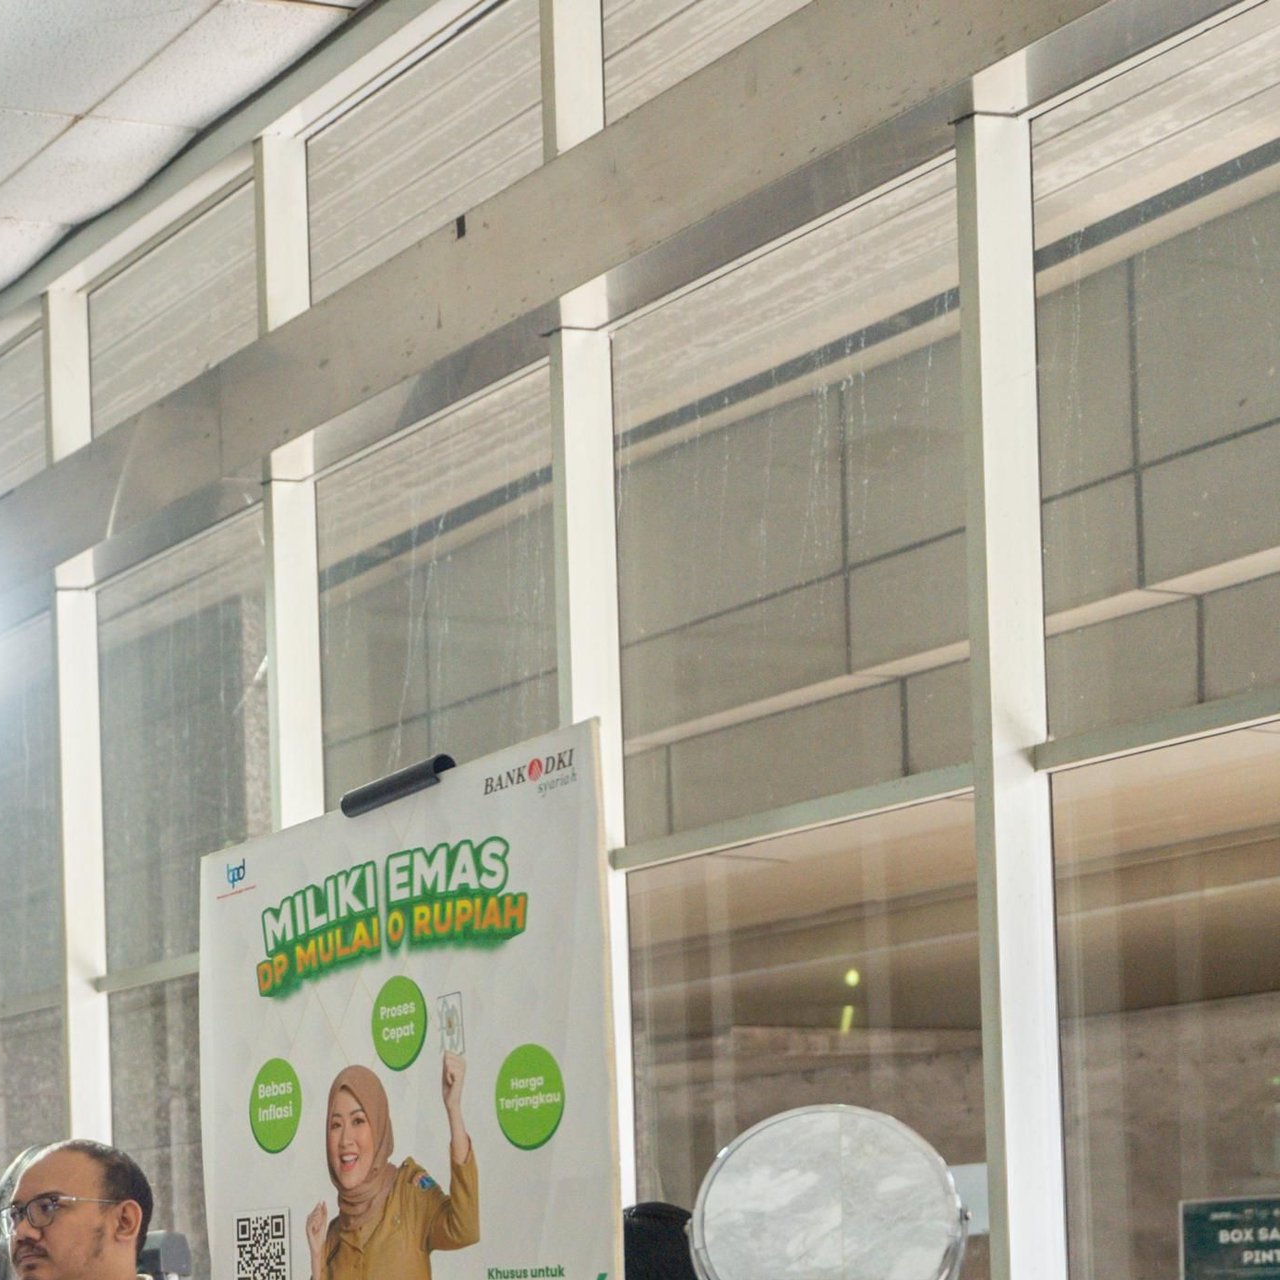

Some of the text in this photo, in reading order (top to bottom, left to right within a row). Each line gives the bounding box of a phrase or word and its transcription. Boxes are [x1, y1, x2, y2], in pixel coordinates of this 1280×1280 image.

[483, 748, 575, 796] BANK DKI
[537, 767, 577, 798] syariah
[263, 838, 509, 954] MILIKI EMAS
[257, 953, 289, 993] DP
[295, 917, 381, 974] MULAI
[413, 895, 526, 938] RUPIAH
[379, 1001, 416, 1021] Proses
[382, 1022, 415, 1043] Cepat
[257, 1079, 293, 1099] Bebas
[510, 1074, 545, 1094] Harga
[499, 1089, 561, 1110] Terjangkau
[258, 1101, 293, 1122] Inflasi
[1219, 1228, 1254, 1244] BOX
[487, 1264, 566, 1280] Khusus untuk
